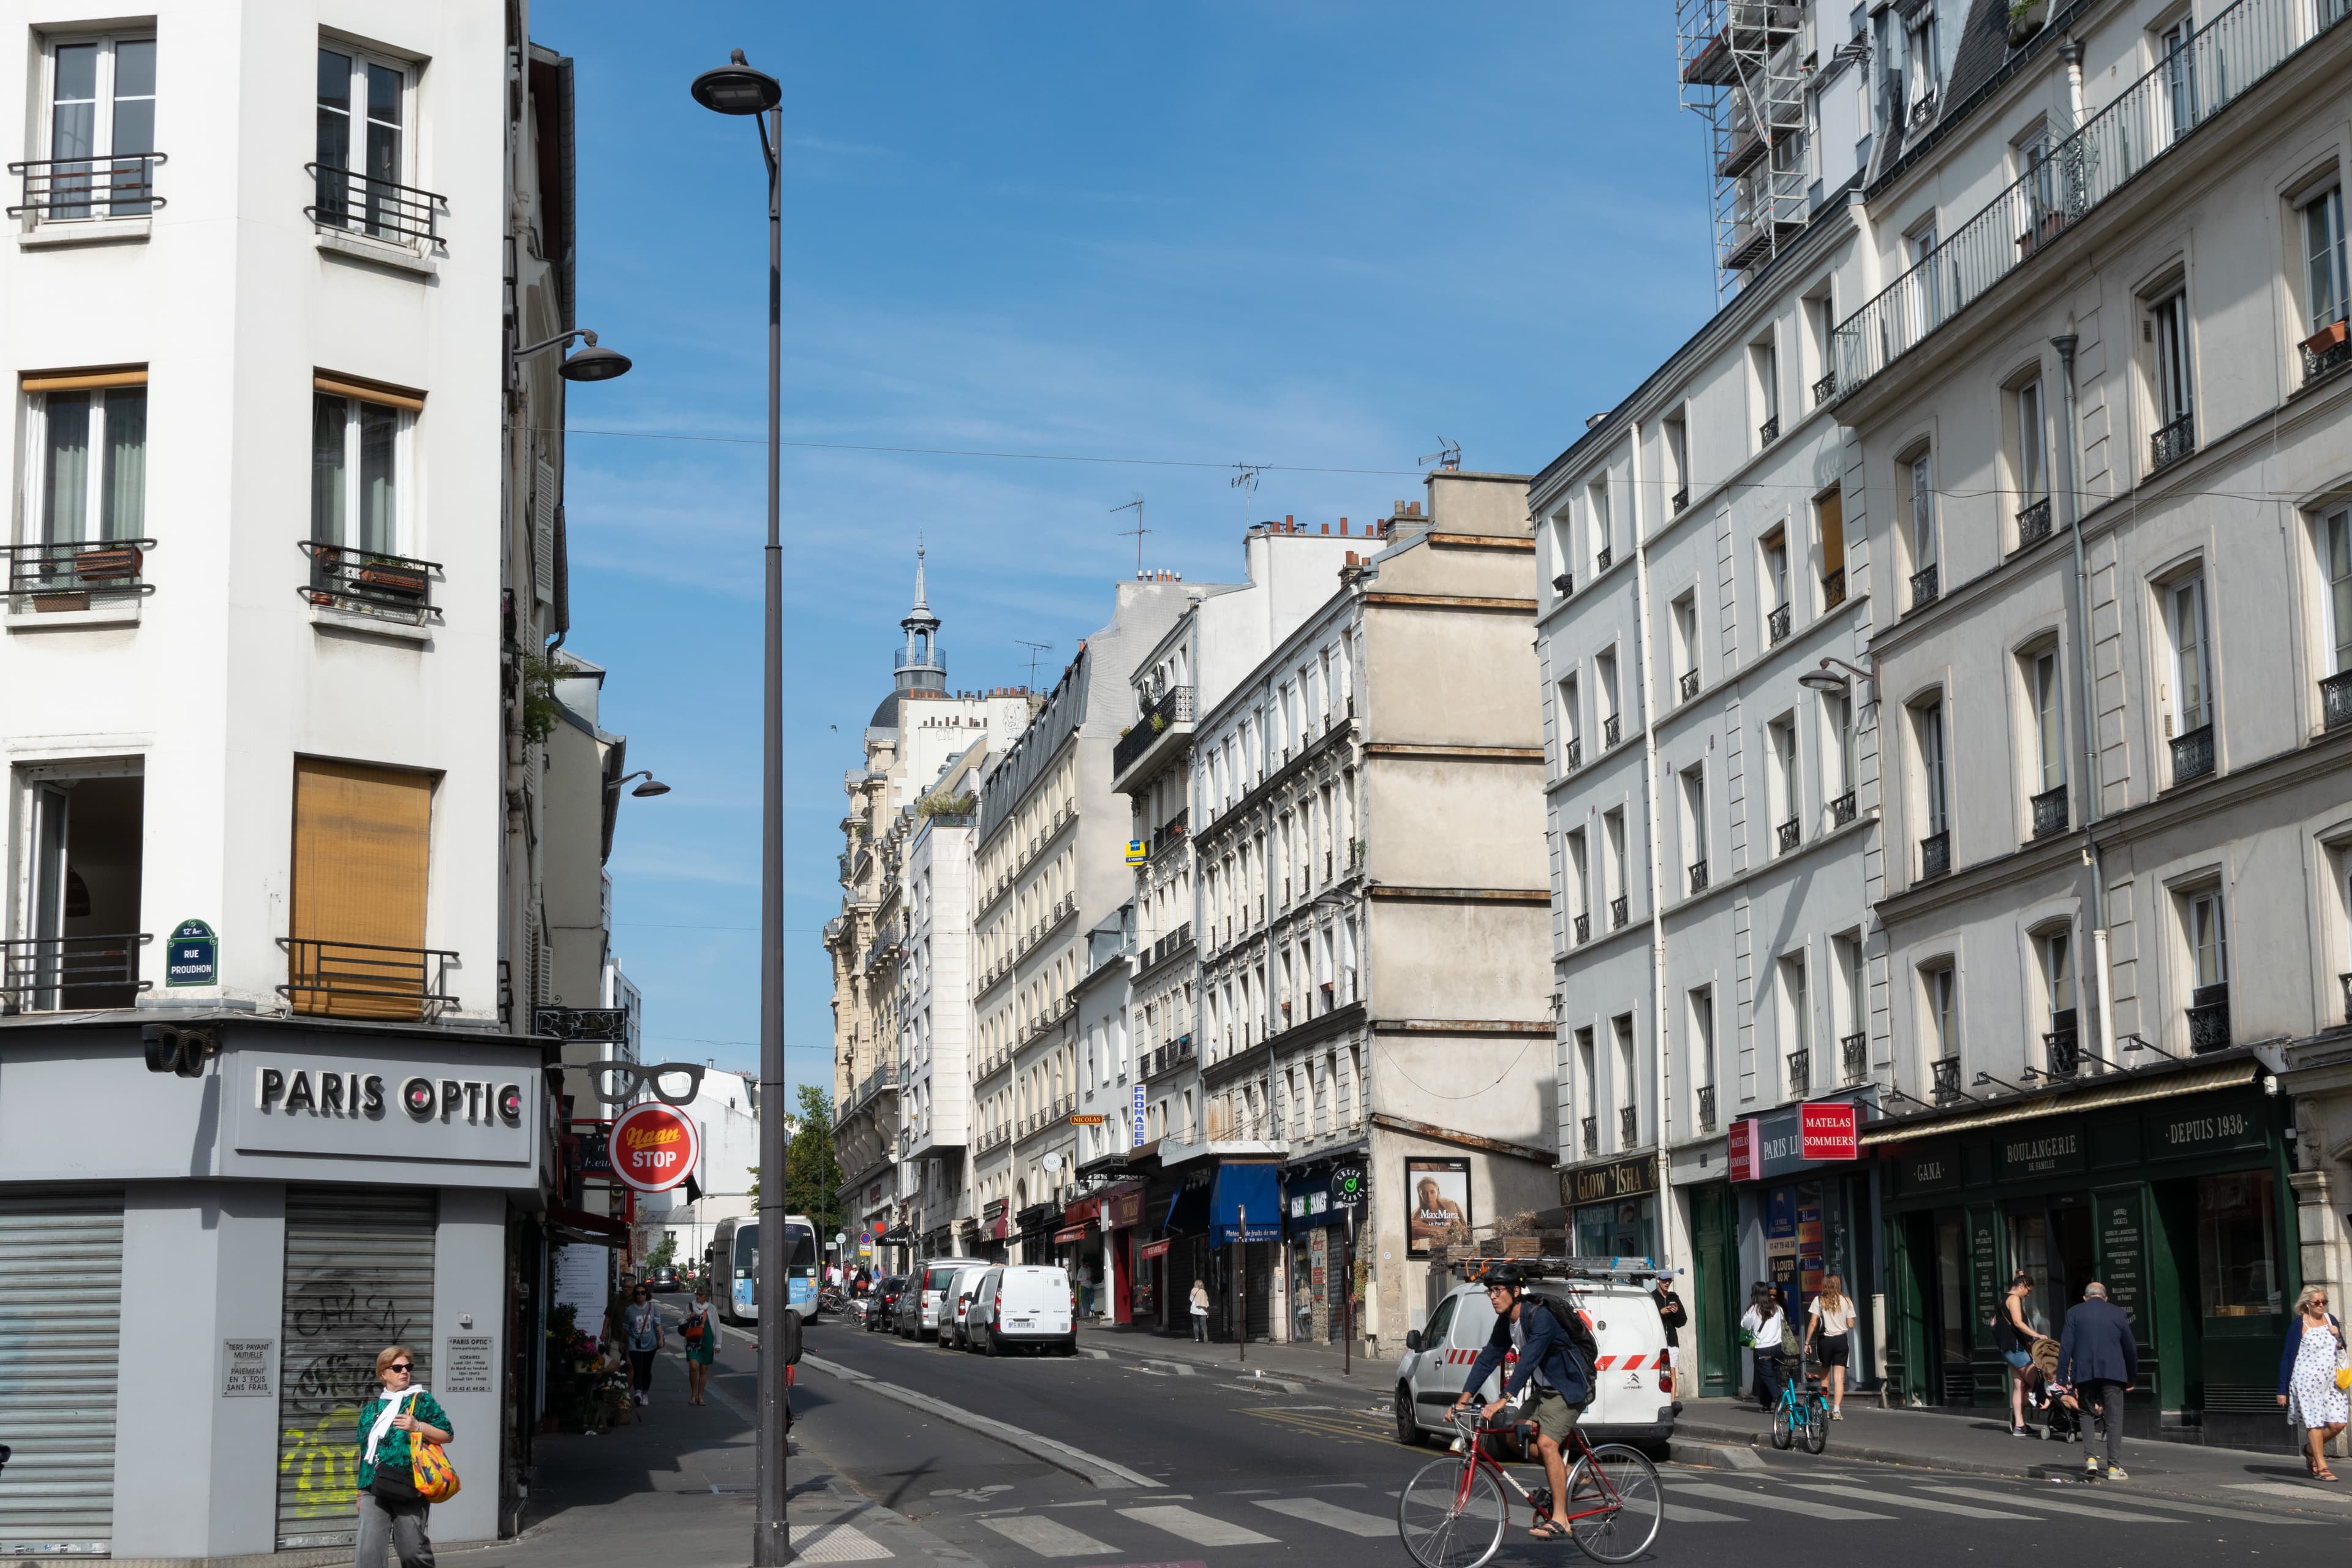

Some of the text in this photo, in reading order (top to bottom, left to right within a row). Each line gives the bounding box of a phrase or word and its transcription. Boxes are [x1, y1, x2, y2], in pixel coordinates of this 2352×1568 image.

[184, 949, 200, 958] RUE
[171, 964, 212, 974] PROUDHON
[256, 1067, 521, 1122] PARIS OPTIC
[1806, 1117, 1851, 1128] MATELAS
[2170, 1114, 2243, 1144] DEPUIS 1938
[626, 1126, 682, 1150] Naan
[1731, 1135, 1749, 1148] MATELAS
[1804, 1136, 1854, 1147] SOMMIERS
[1763, 1137, 1787, 1161] PARIS
[2007, 1134, 2077, 1163] BOULANGERIE
[632, 1151, 677, 1167] STOP
[1730, 1155, 1751, 1167] SOMMIERS
[2028, 1159, 2056, 1171] DE FAMILLE
[1336, 1169, 1361, 1181] CHECK
[1917, 1162, 1942, 1182] GANA
[1577, 1170, 1606, 1200] GLOW
[1615, 1164, 1642, 1194] ISHA
[1338, 1188, 1365, 1202] PLANET
[1122, 1200, 1138, 1218] NICOLAS
[1420, 1208, 1459, 1219] MaxMara
[2113, 1217, 2128, 1226] LOCALES
[1776, 1224, 1792, 1233] COMMERCE
[1776, 1259, 1795, 1272] LOUER
